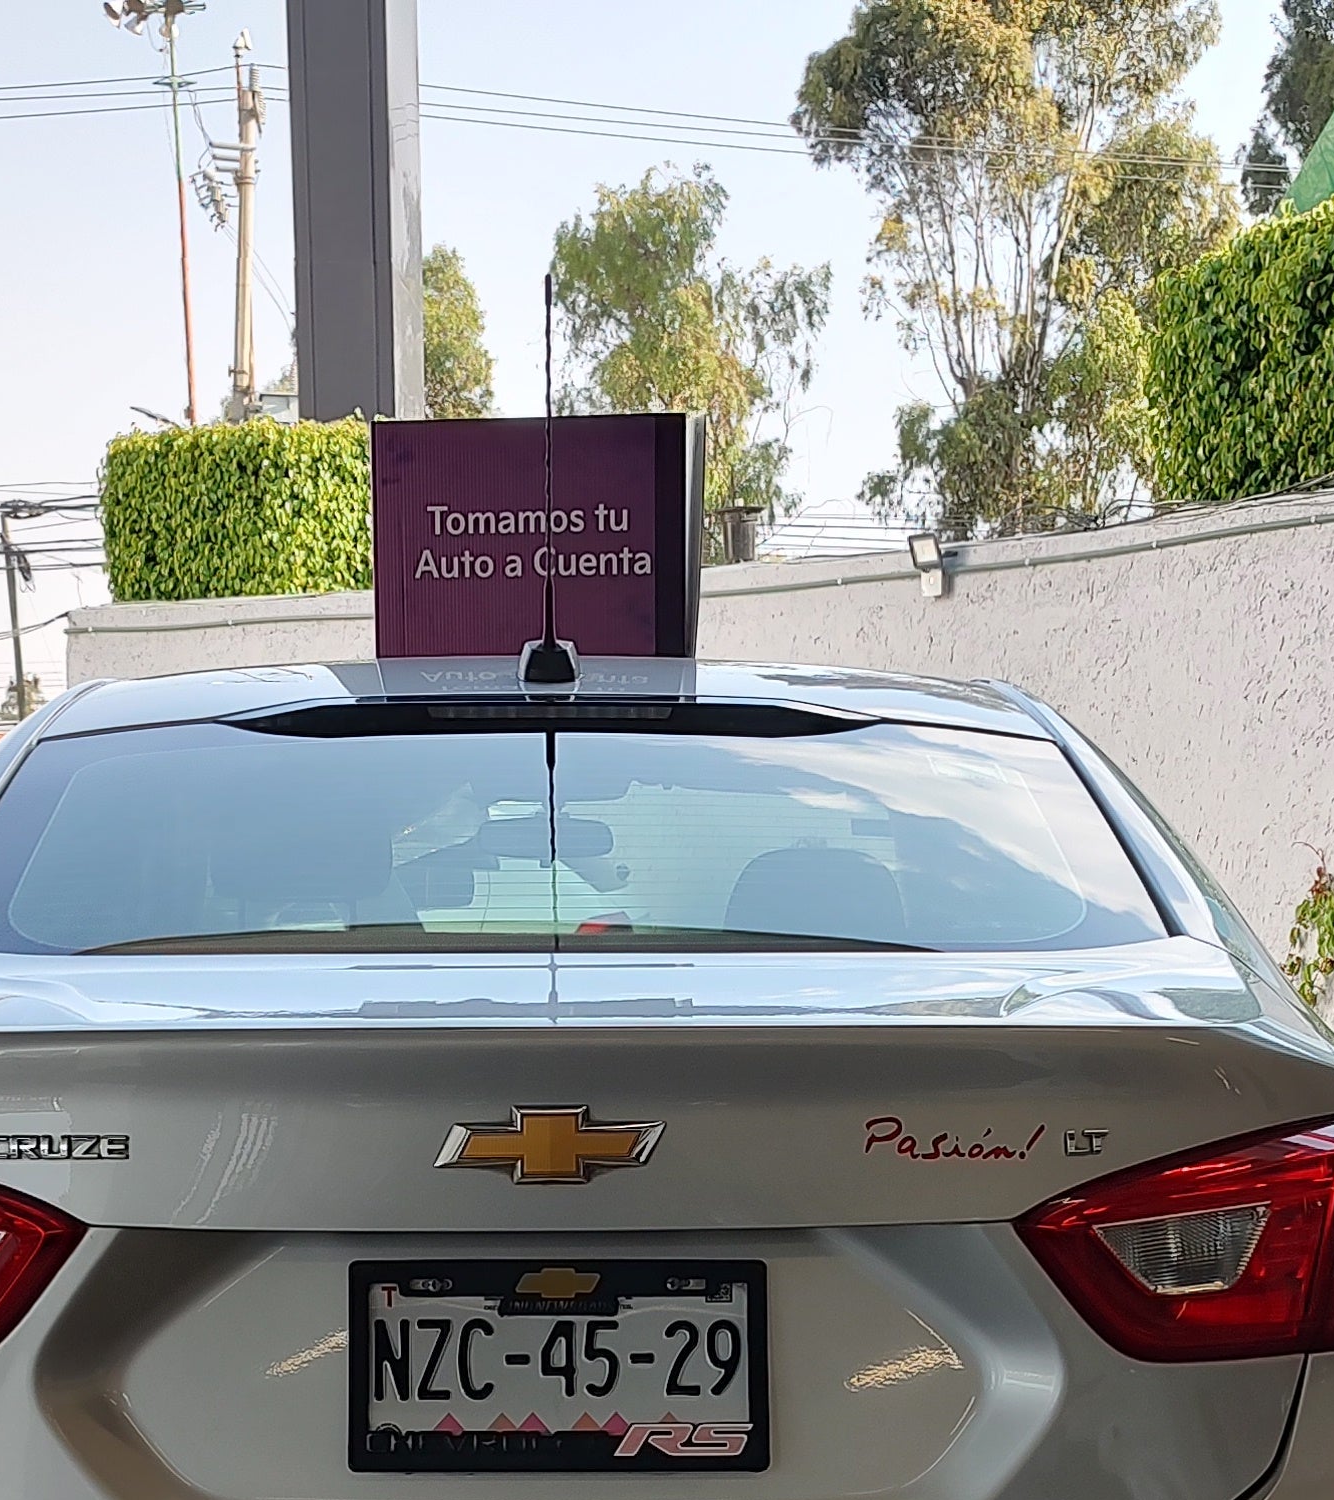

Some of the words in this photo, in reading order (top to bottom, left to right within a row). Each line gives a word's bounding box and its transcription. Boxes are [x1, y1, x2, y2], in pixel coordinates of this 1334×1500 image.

[427, 505, 585, 536] Tomamos
[594, 503, 630, 532] tu
[414, 549, 495, 579] Auto
[505, 554, 523, 577] a
[533, 546, 653, 577] Cuenta
[864, 1116, 1045, 1160] Pasión!
[1064, 1129, 1110, 1156] LT
[381, 1286, 397, 1308] T
[374, 1318, 742, 1402] NZC-45-29
[613, 1423, 754, 1457] RS
